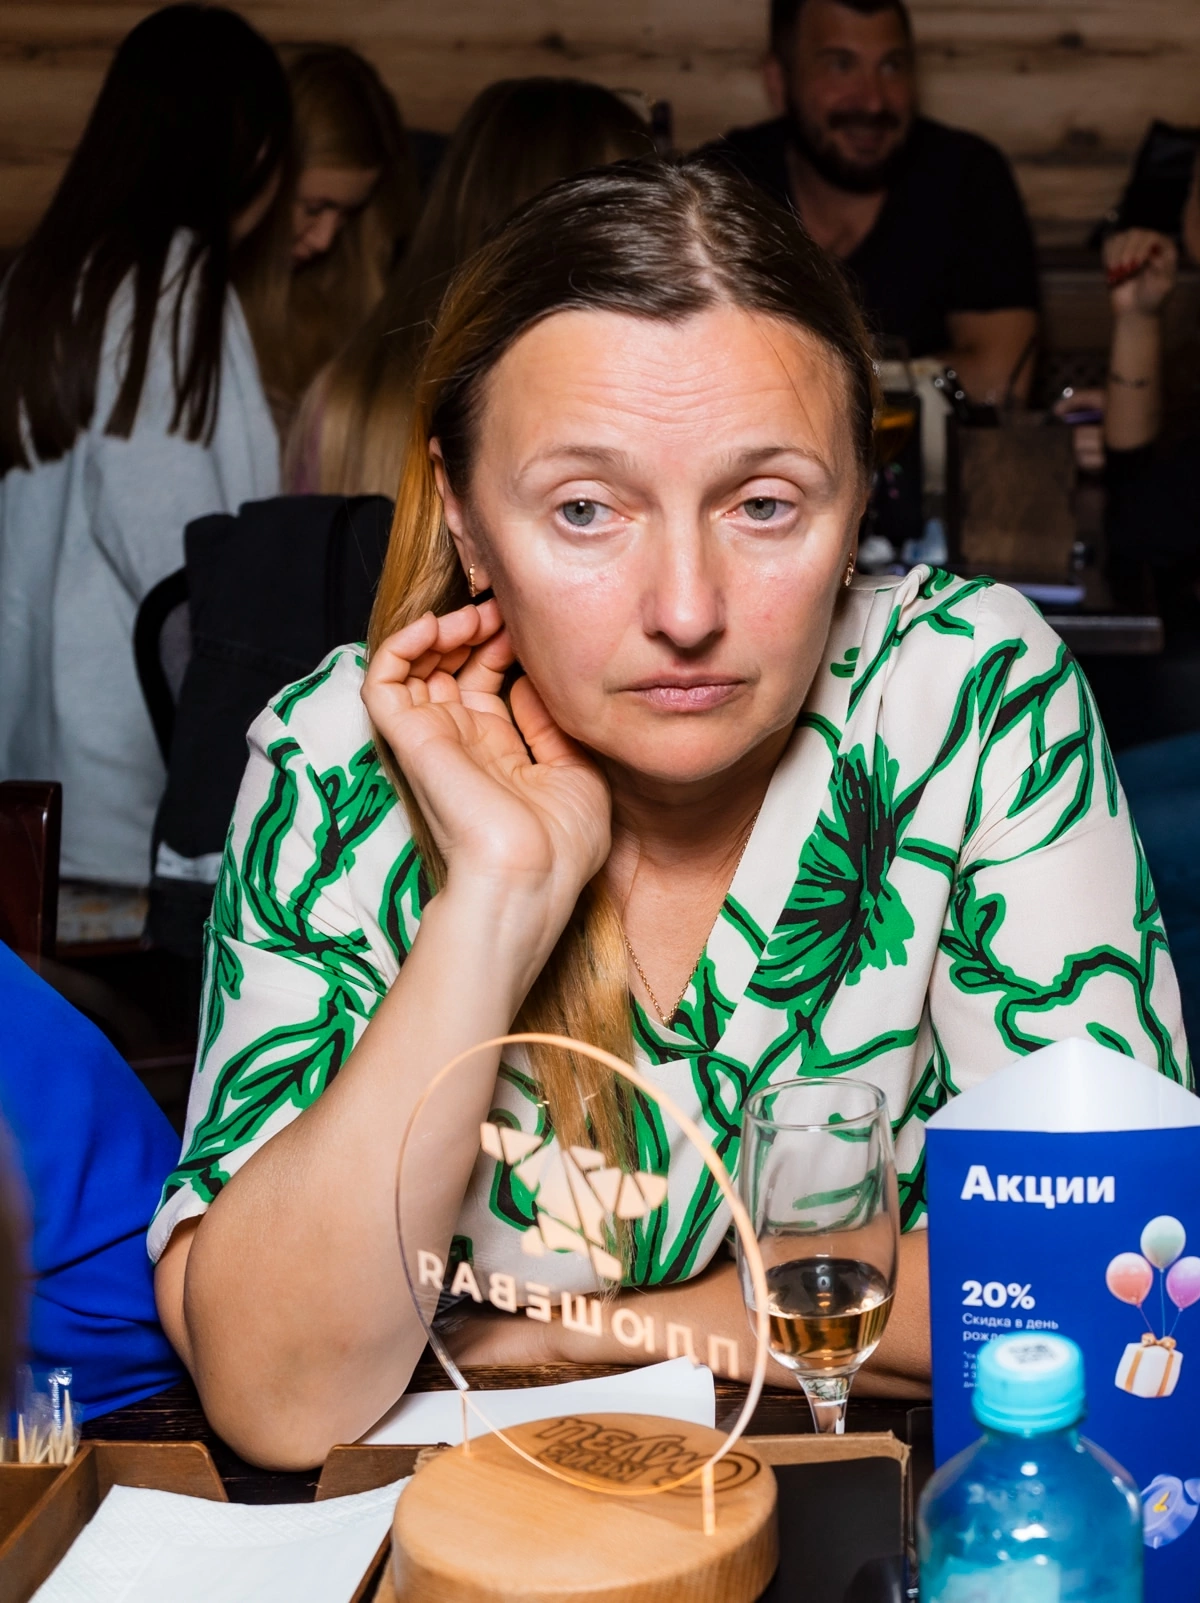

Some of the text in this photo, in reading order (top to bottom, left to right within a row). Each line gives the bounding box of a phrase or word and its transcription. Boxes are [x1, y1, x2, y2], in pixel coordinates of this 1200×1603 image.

[960, 1165, 1116, 1210] Акции
[961, 1279, 1036, 1310] 20%
[962, 1312, 1059, 1330] Скидка в день
